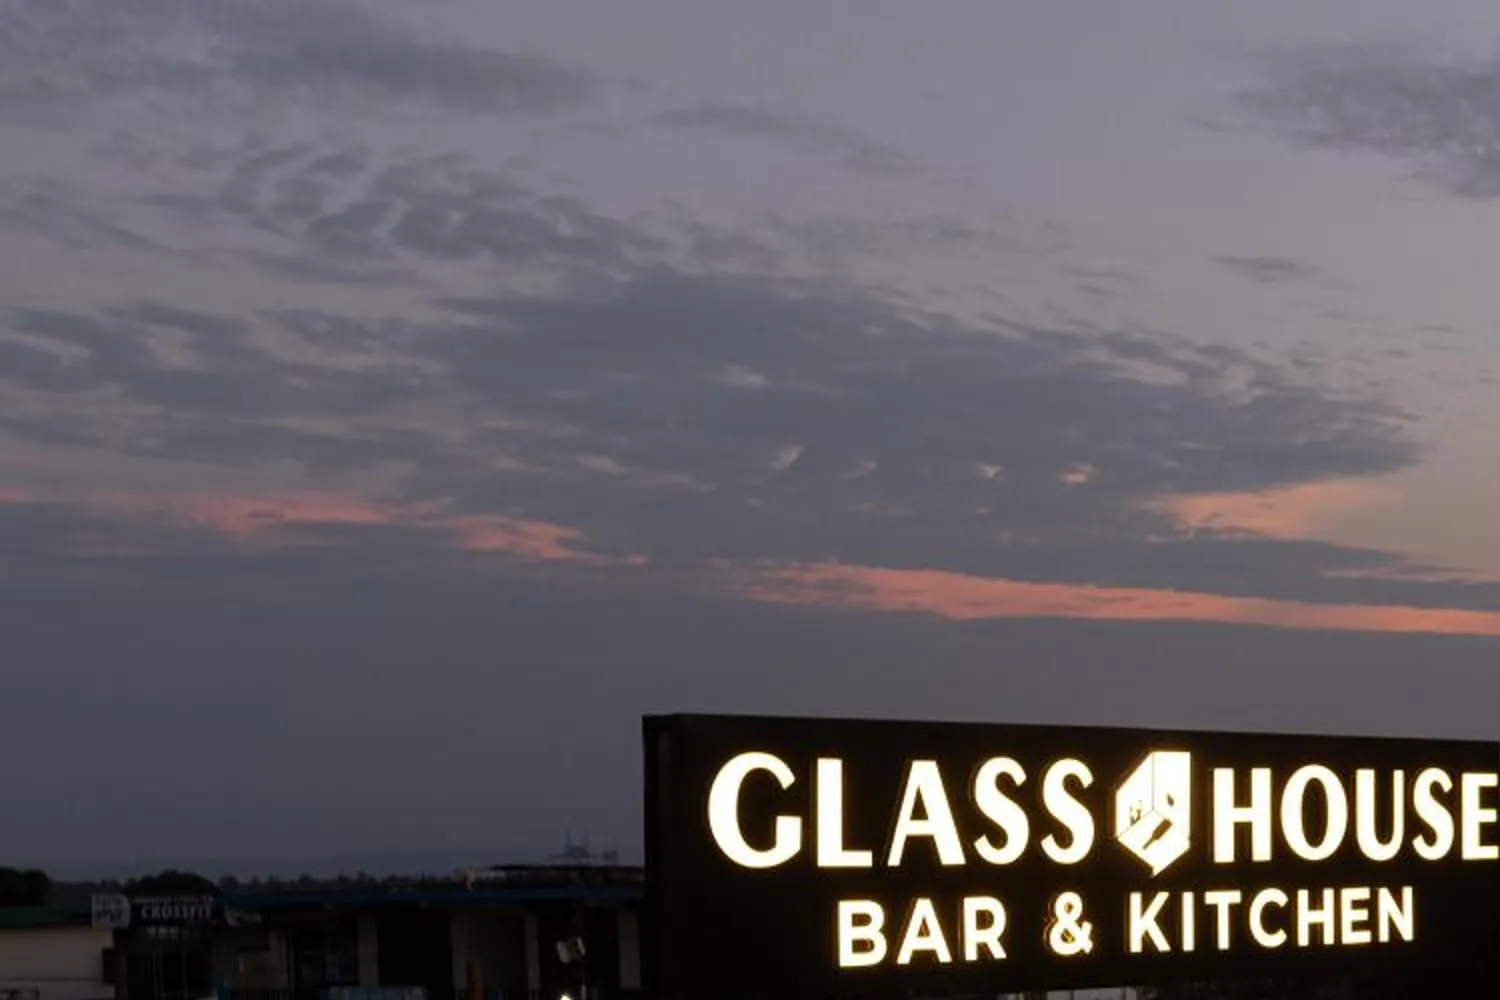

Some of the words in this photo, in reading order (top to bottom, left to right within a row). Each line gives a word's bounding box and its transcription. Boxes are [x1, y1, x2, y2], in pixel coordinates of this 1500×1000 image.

[707, 751, 1095, 869] GLASS
[1213, 764, 1499, 863] HOUSE
[838, 896, 1007, 967] BAR
[1049, 891, 1093, 956] &
[1129, 886, 1414, 953] KITCHEN
